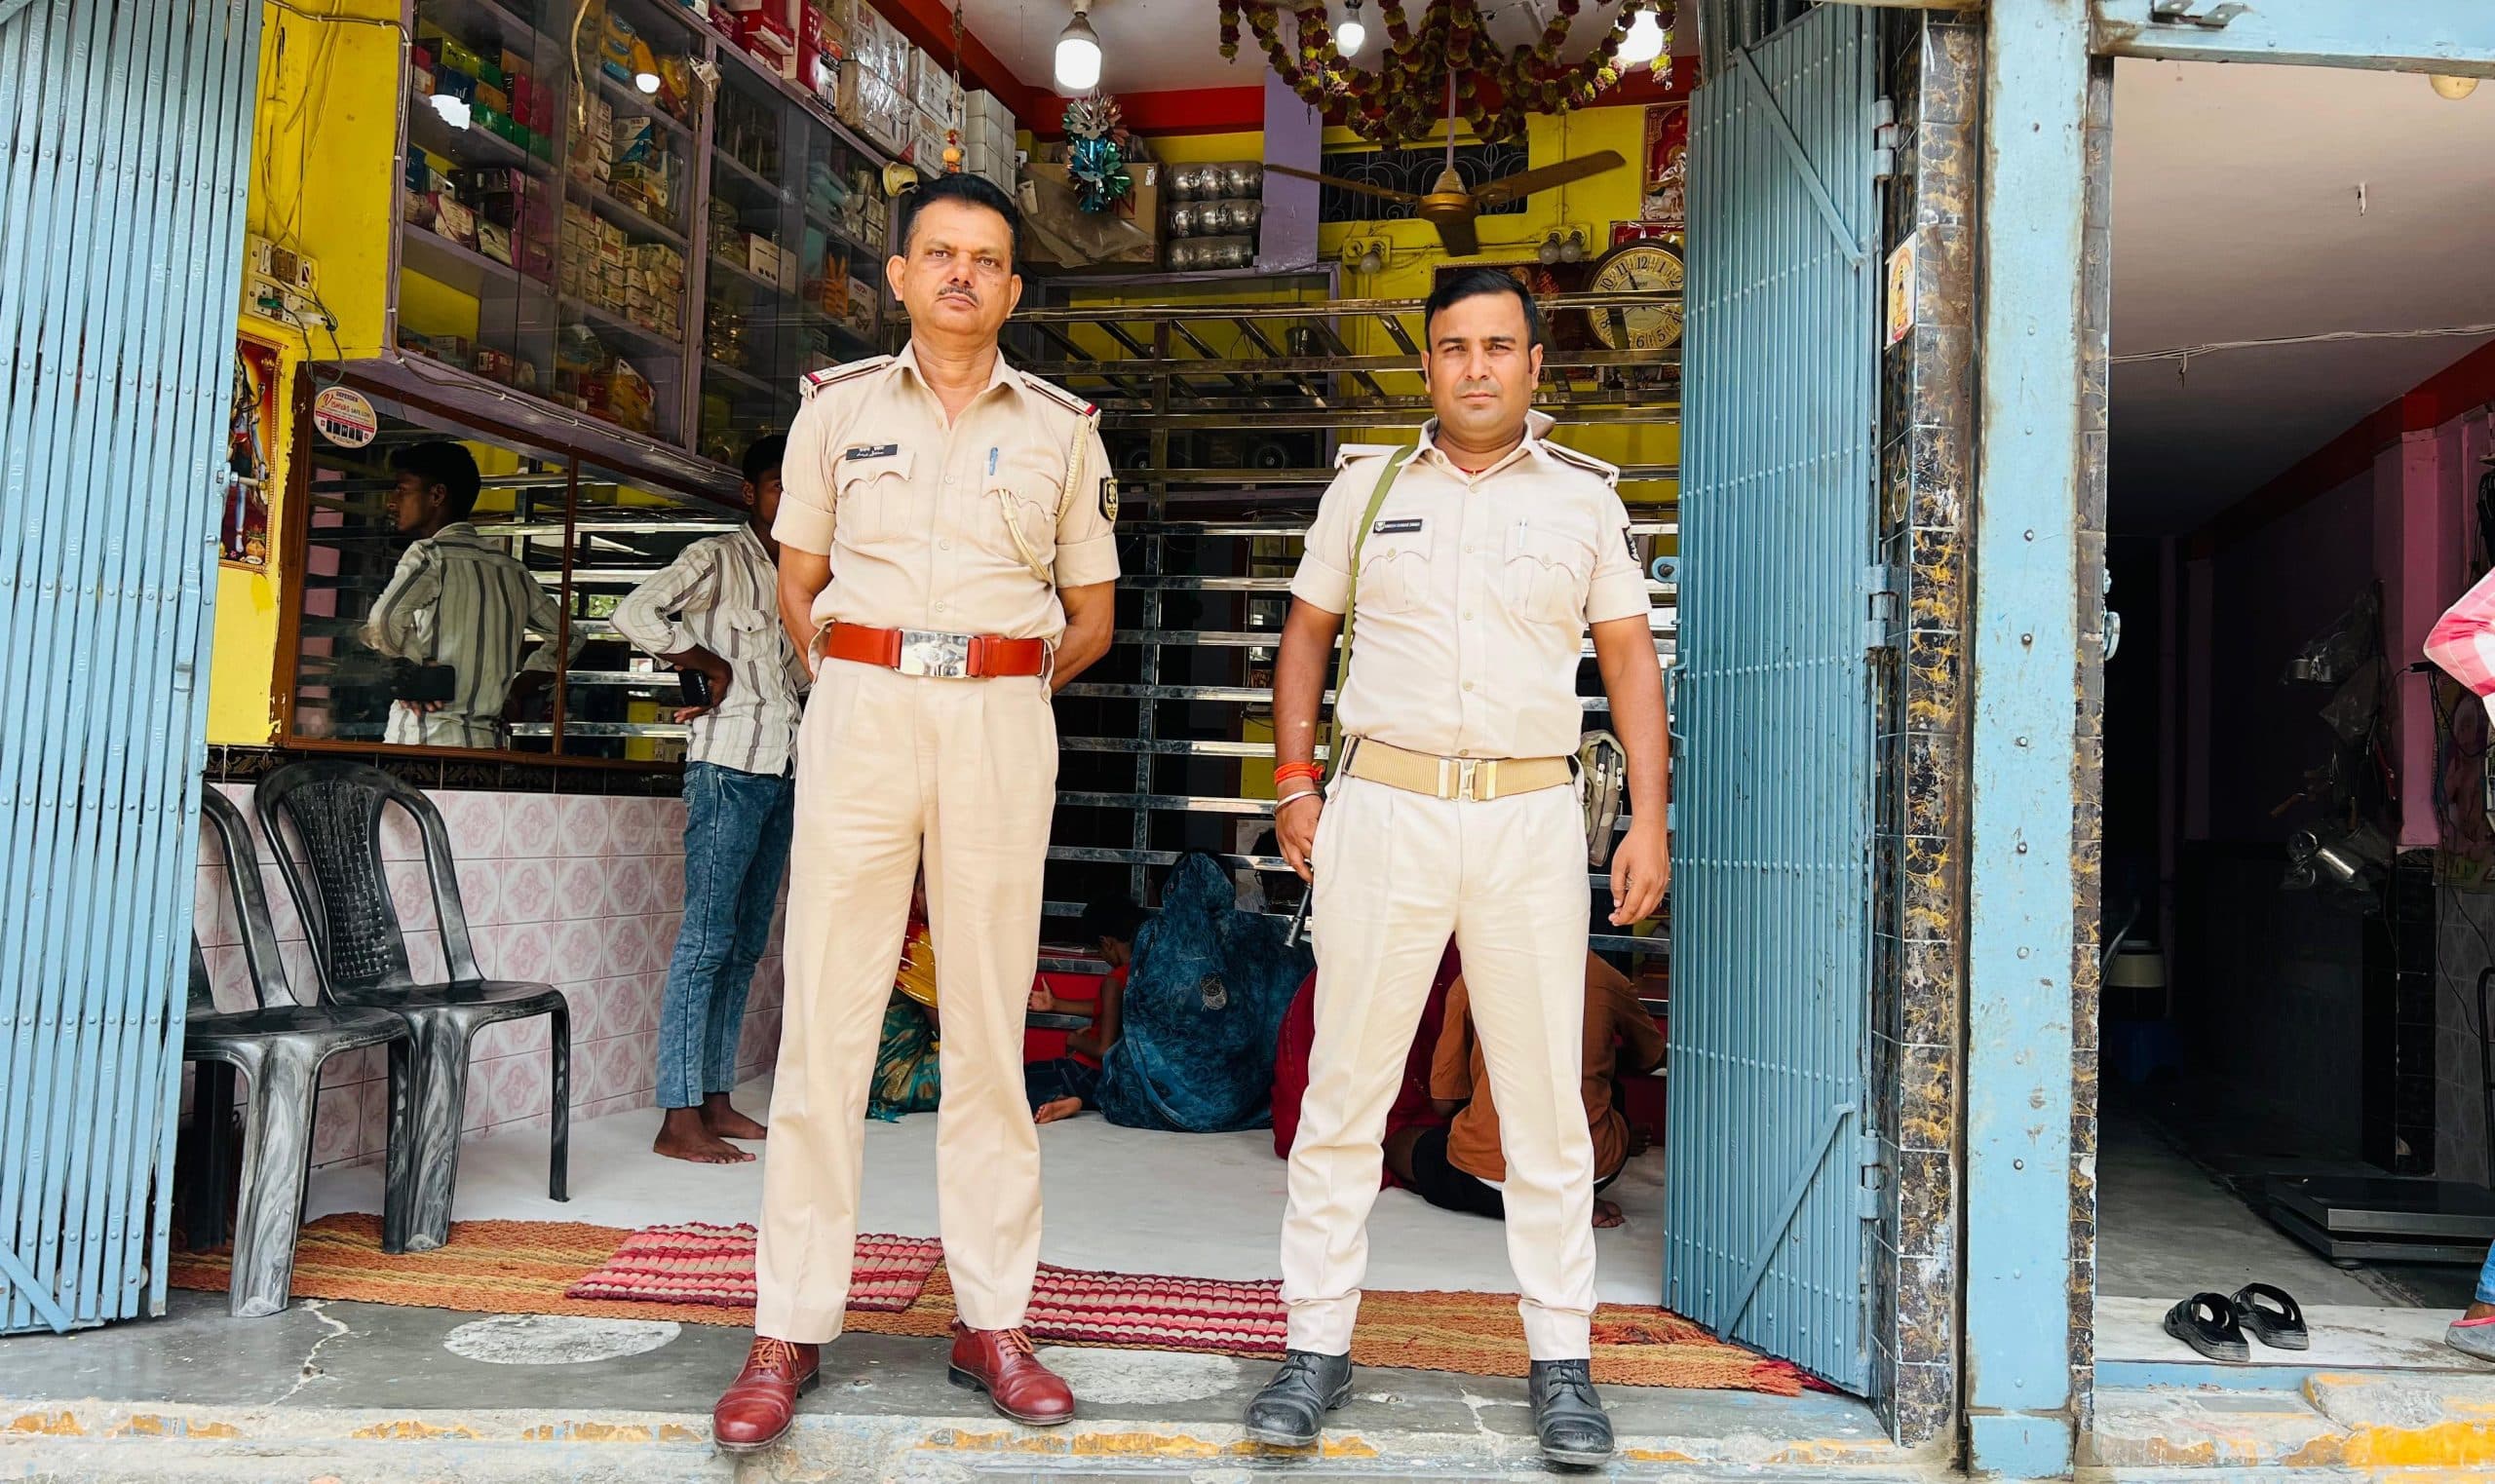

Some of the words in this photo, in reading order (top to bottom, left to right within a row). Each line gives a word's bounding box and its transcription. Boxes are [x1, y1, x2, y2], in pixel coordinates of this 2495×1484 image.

[1616, 262, 1629, 276] 11
[1636, 256, 1648, 270] 12
[1659, 261, 1667, 274] 1
[1600, 278, 1614, 290] 10
[1670, 275, 1683, 287] 2
[1600, 318, 1611, 329] 8
[1636, 334, 1645, 348] 6
[1657, 328, 1667, 342] 5
